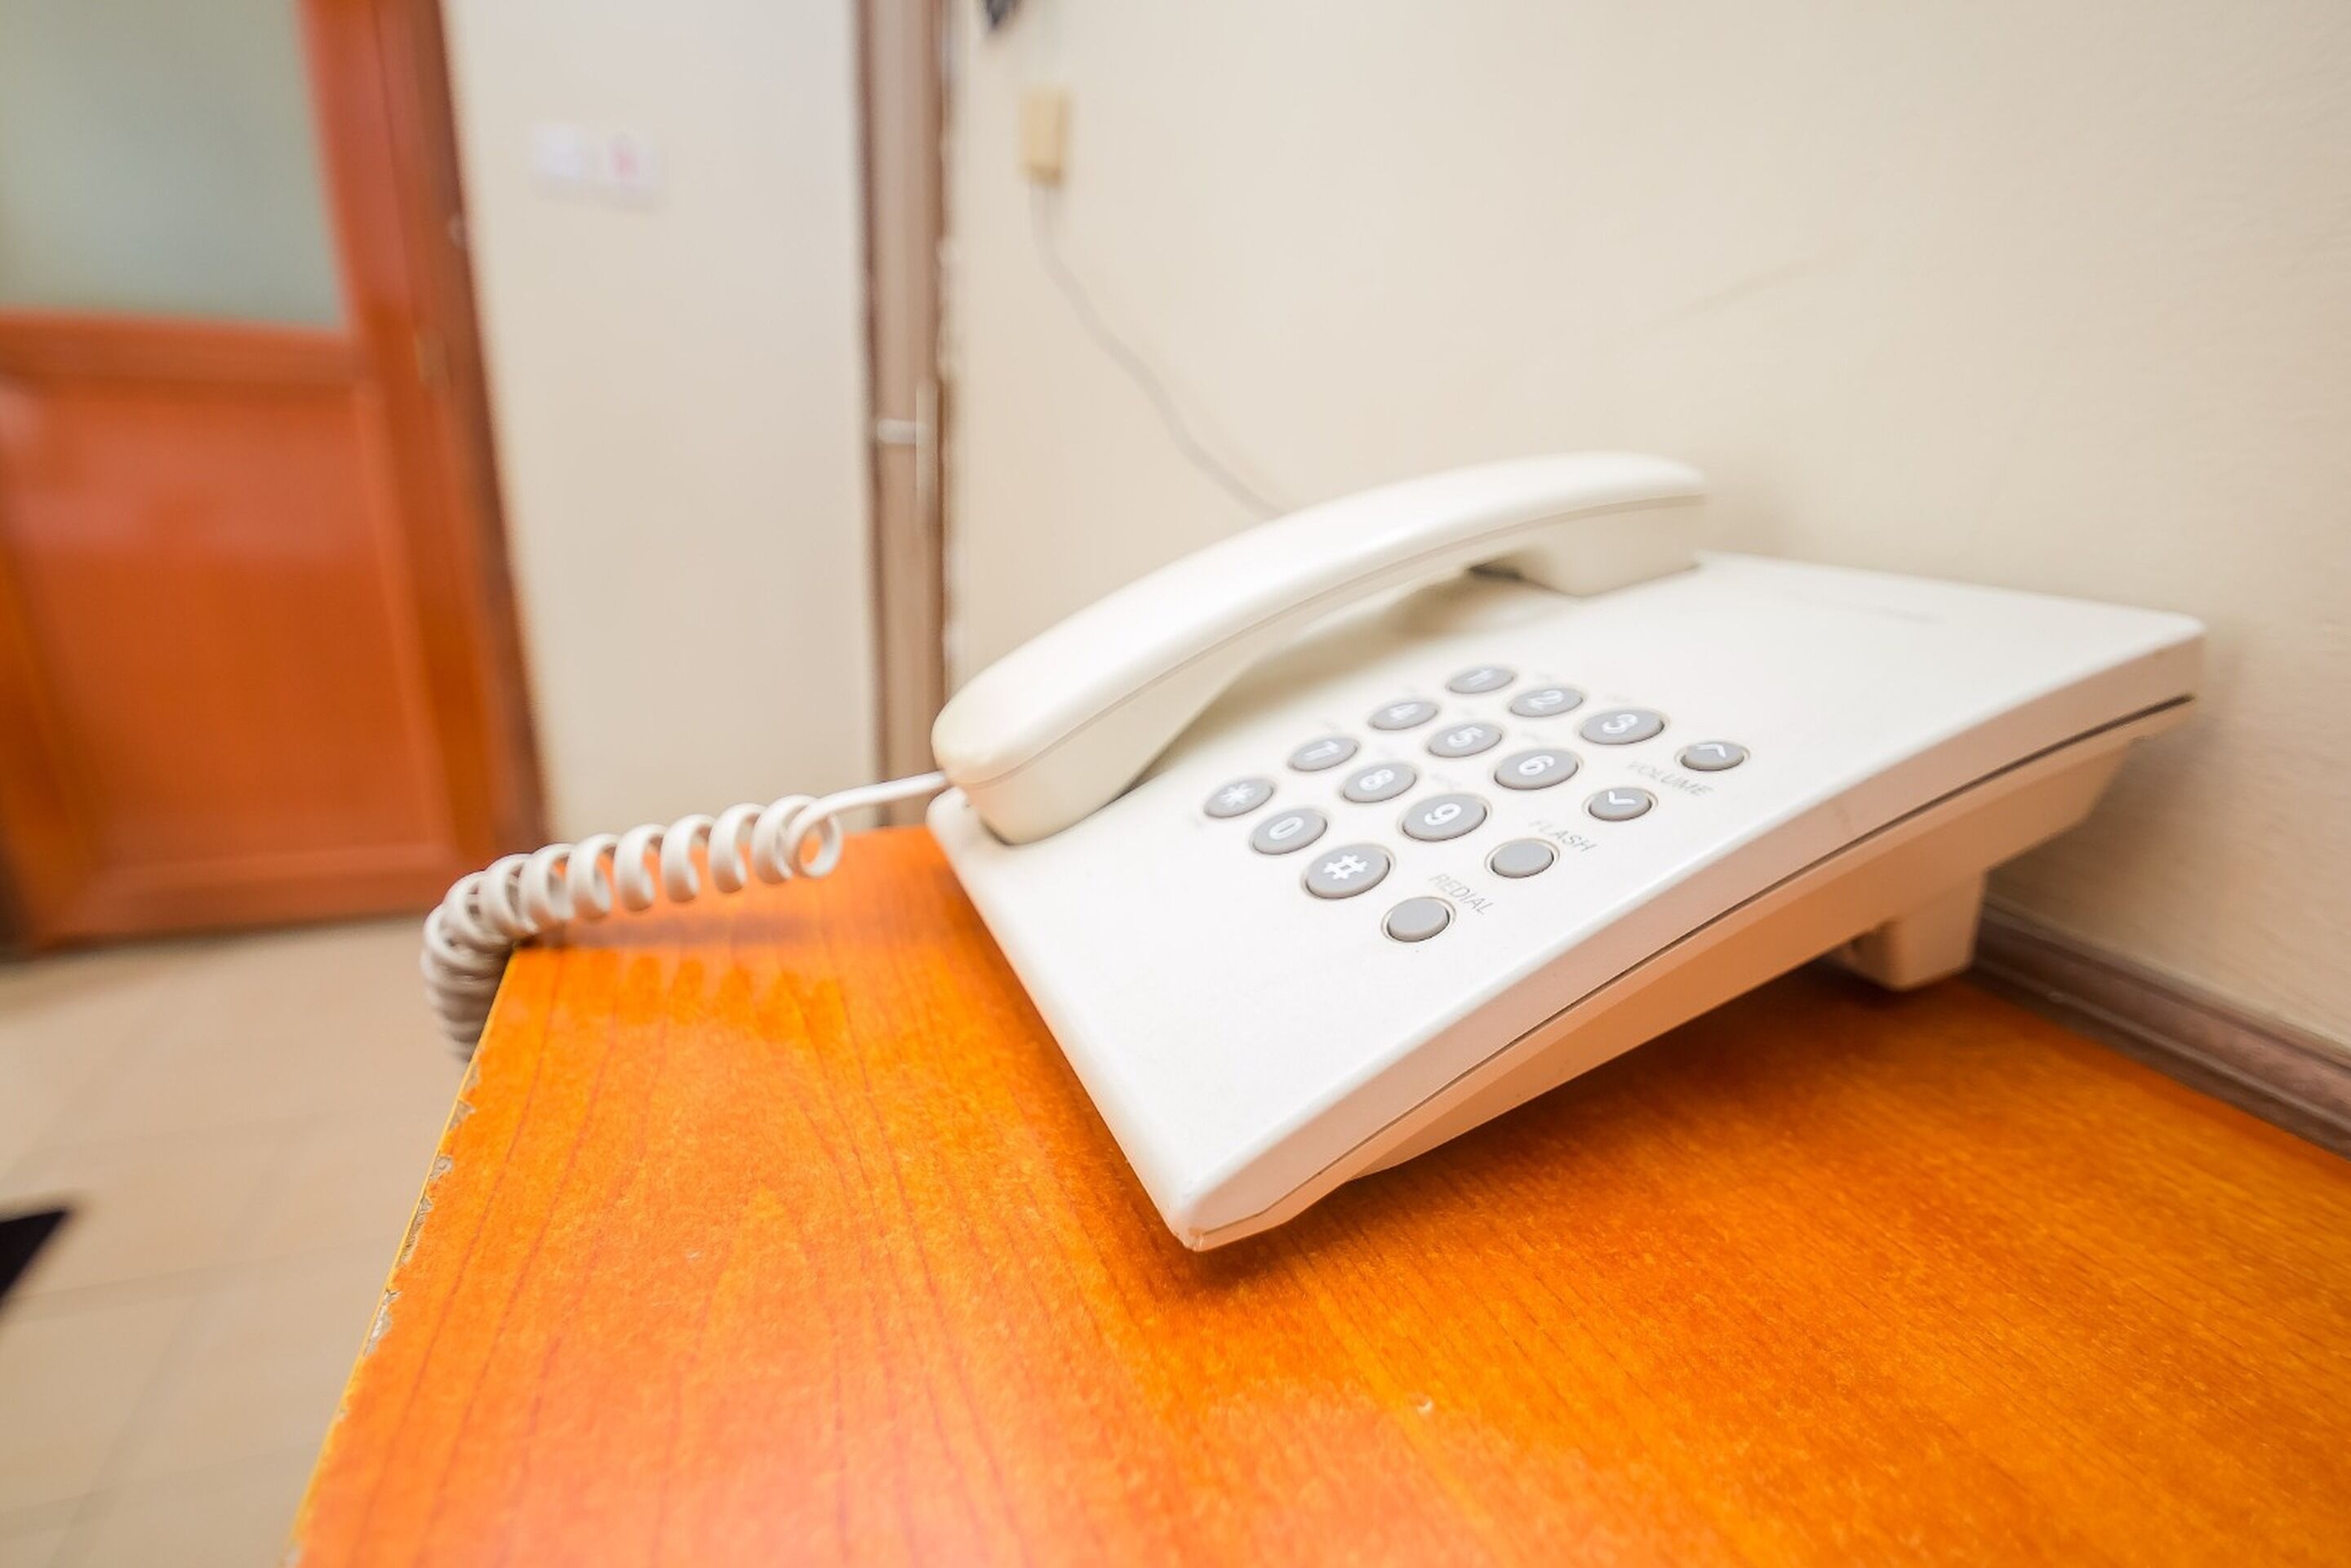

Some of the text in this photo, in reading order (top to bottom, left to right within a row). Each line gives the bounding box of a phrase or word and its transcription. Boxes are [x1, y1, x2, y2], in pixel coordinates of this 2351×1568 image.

[1527, 690, 1564, 710] 2
[1602, 713, 1638, 735] 3
[1447, 726, 1485, 748] 5
[1305, 740, 1340, 760] 7
[1518, 754, 1556, 776] 6
[1359, 769, 1395, 791] 8
[1628, 762, 1714, 797] VOLUME
[1424, 802, 1462, 826] 9
[1269, 816, 1304, 840] 0
[1530, 819, 1598, 853] FLASH
[1429, 872, 1495, 915] REDIAL
